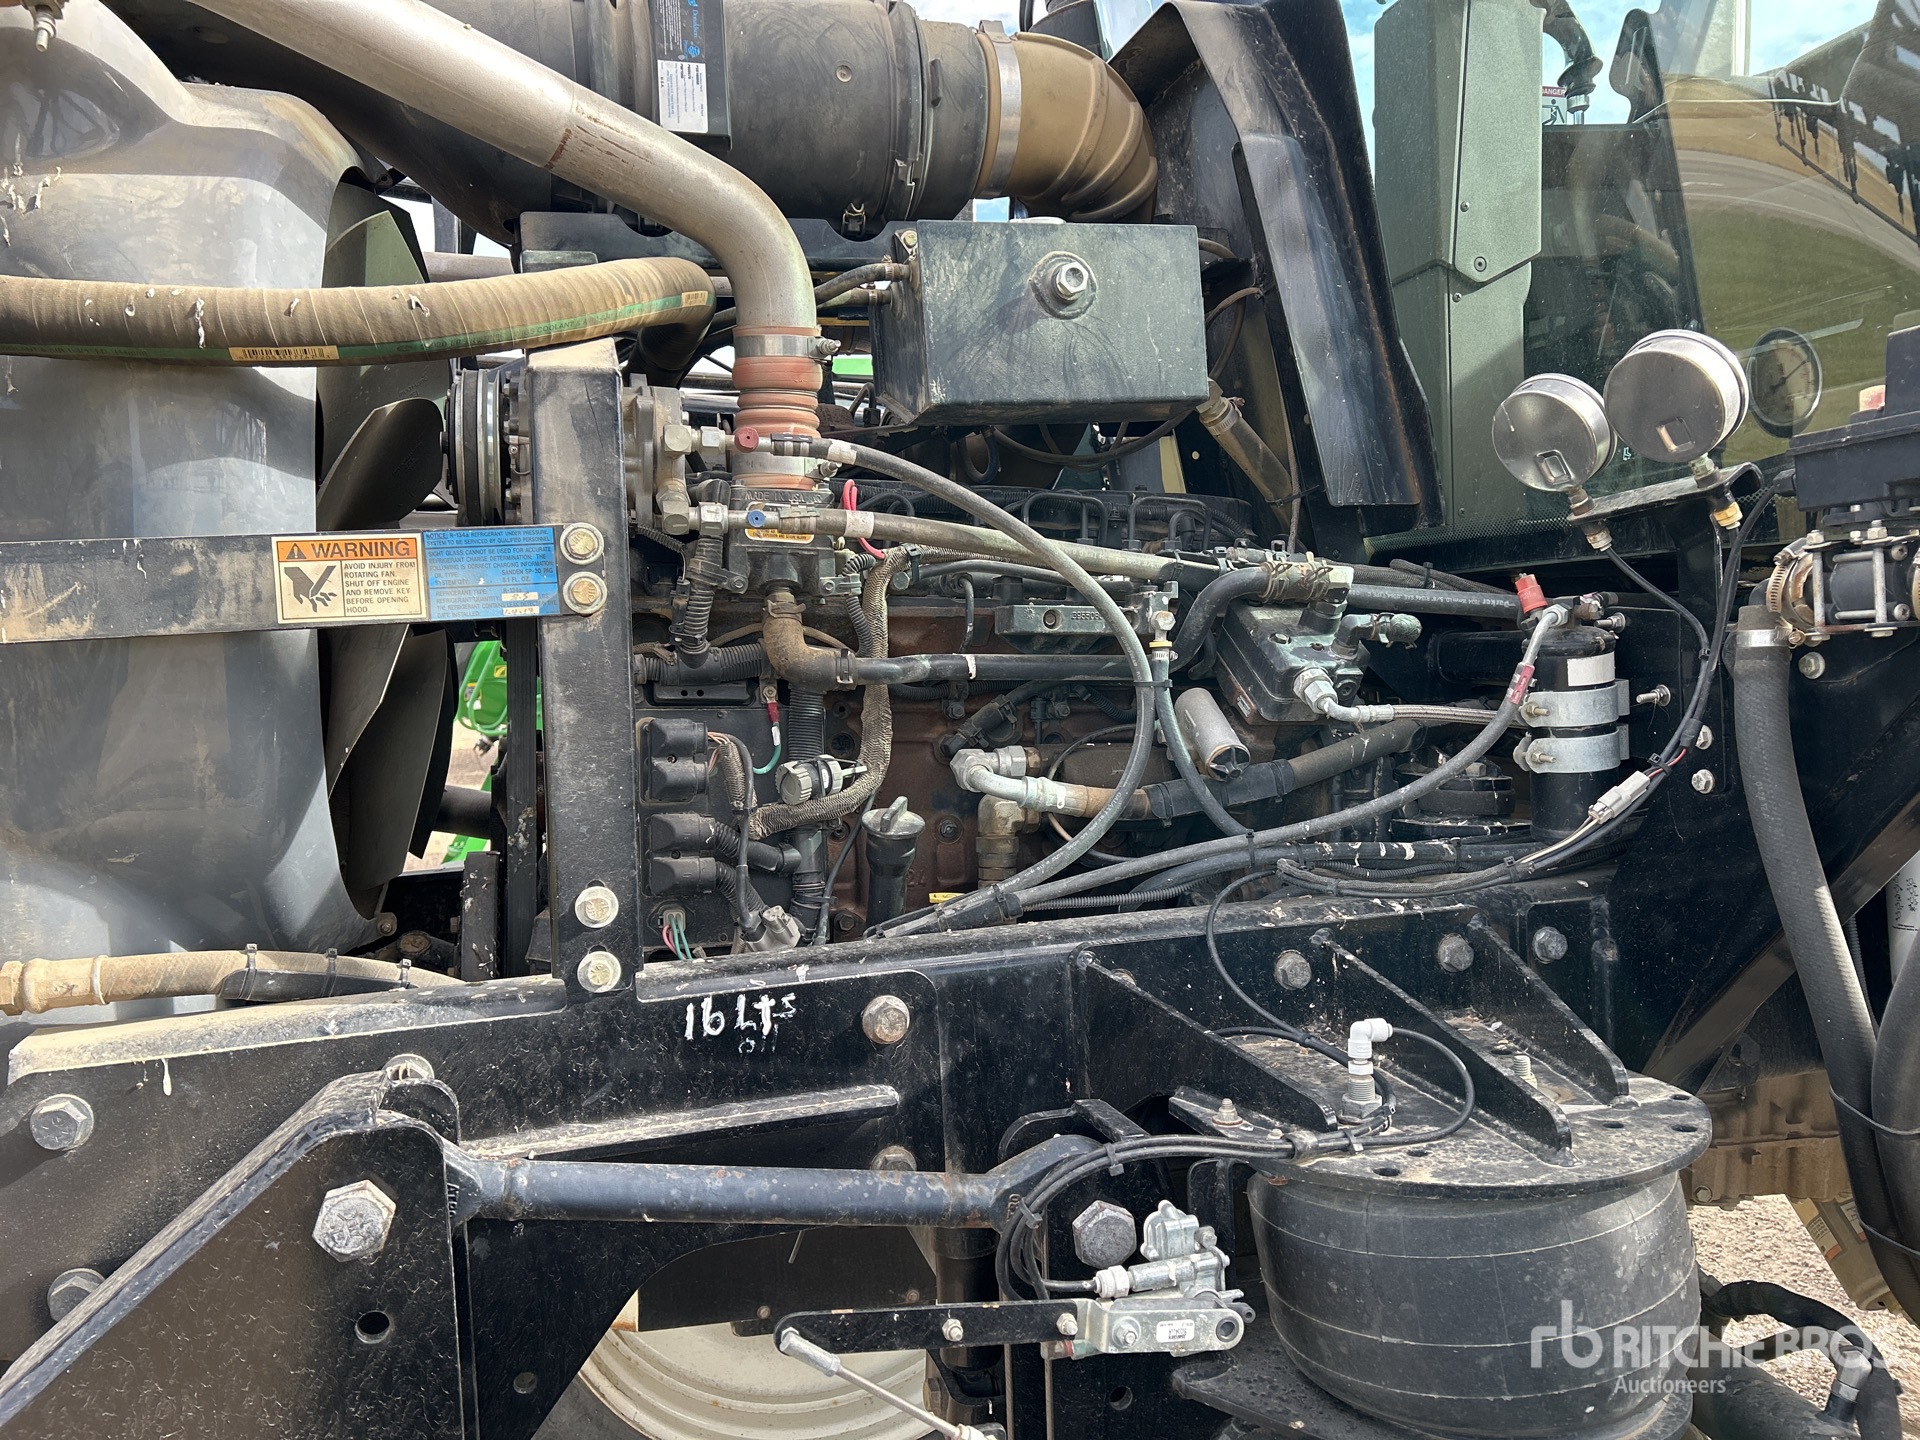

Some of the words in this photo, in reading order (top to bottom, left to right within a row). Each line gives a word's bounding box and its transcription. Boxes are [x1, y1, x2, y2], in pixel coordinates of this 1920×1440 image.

[537, 322, 573, 332] COOLANT
[745, 492, 769, 500] MADE
[311, 540, 410, 558] WARNING
[1482, 598, 1514, 608] Parker
[1104, 792, 1122, 815] GALAXY
[684, 994, 726, 1040] 16
